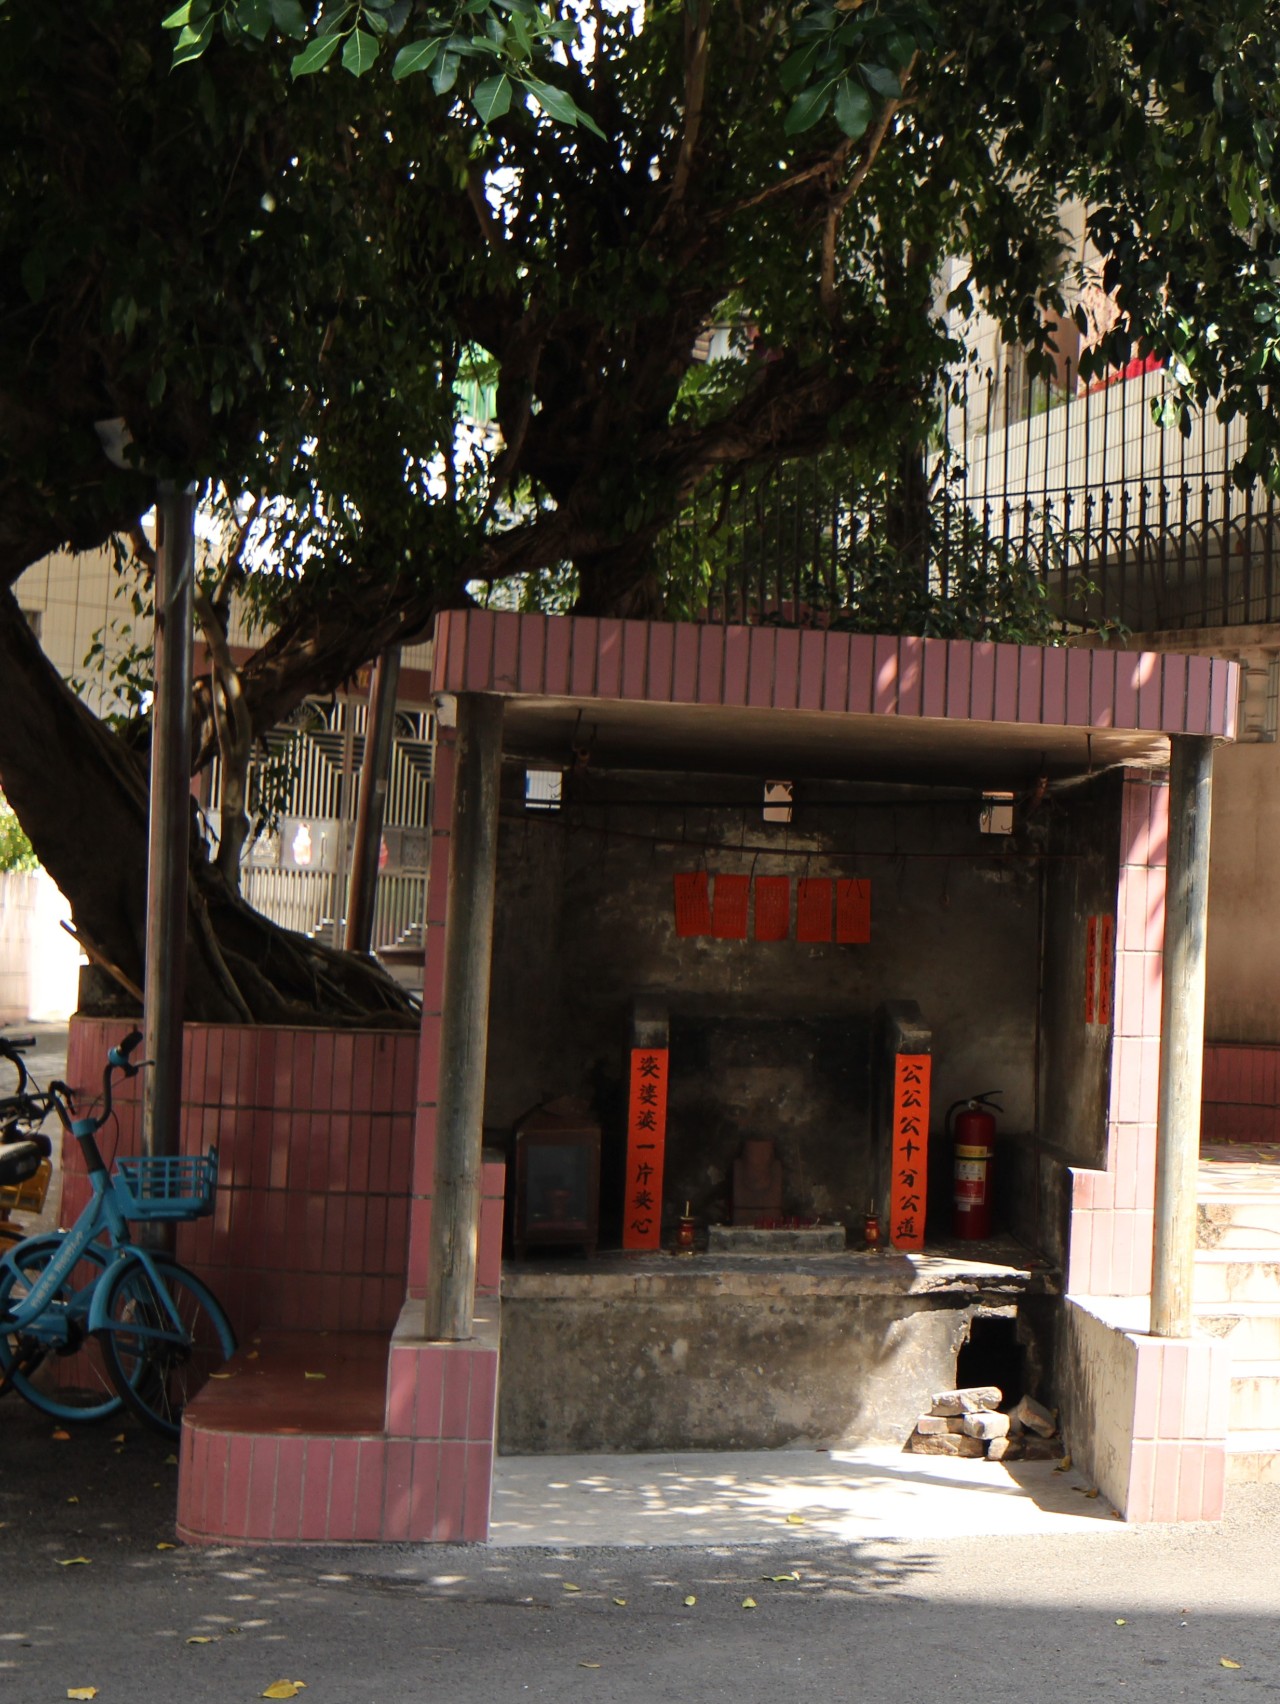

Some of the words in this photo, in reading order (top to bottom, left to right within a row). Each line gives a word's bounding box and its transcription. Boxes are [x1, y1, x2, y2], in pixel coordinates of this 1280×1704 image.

[896, 1064, 923, 1239] 公公公十分公道
